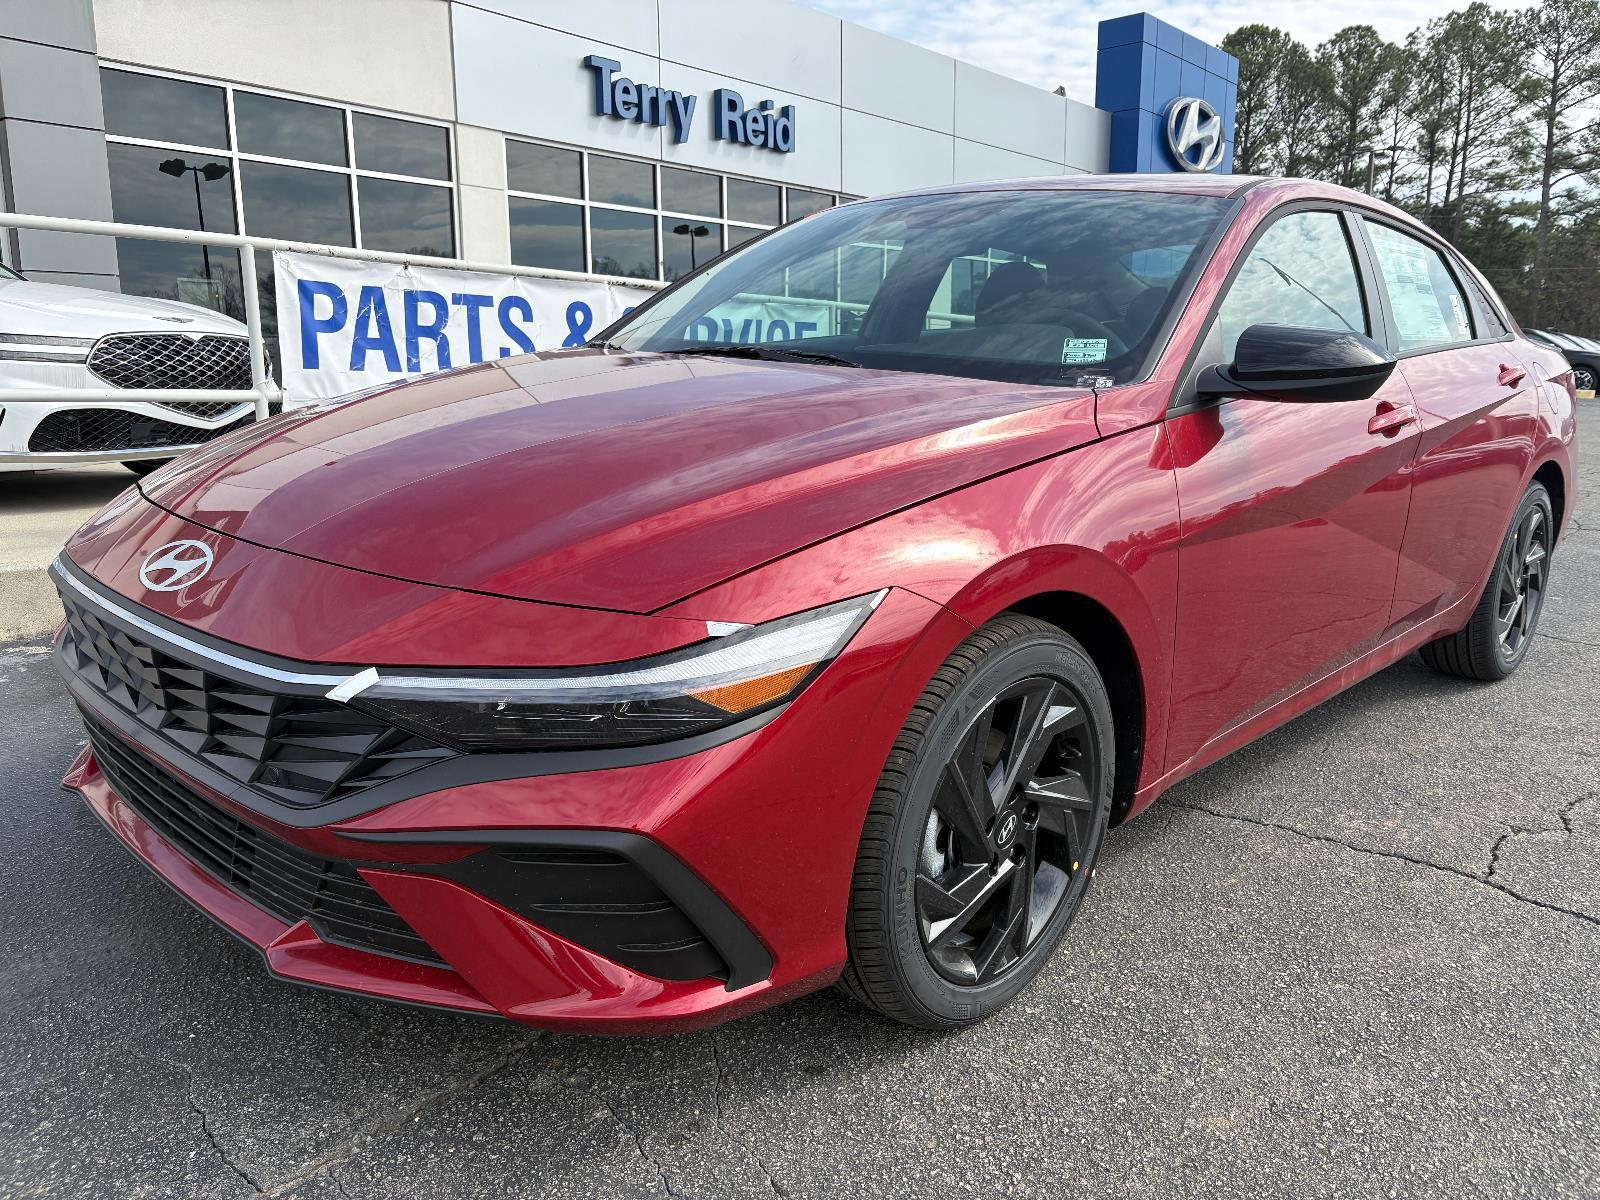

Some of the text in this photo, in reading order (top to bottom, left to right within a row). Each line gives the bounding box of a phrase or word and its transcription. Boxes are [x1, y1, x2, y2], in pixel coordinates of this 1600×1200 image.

[584, 54, 796, 153] Terry Reid
[297, 279, 535, 373] PARTS
[562, 300, 593, 348] &
